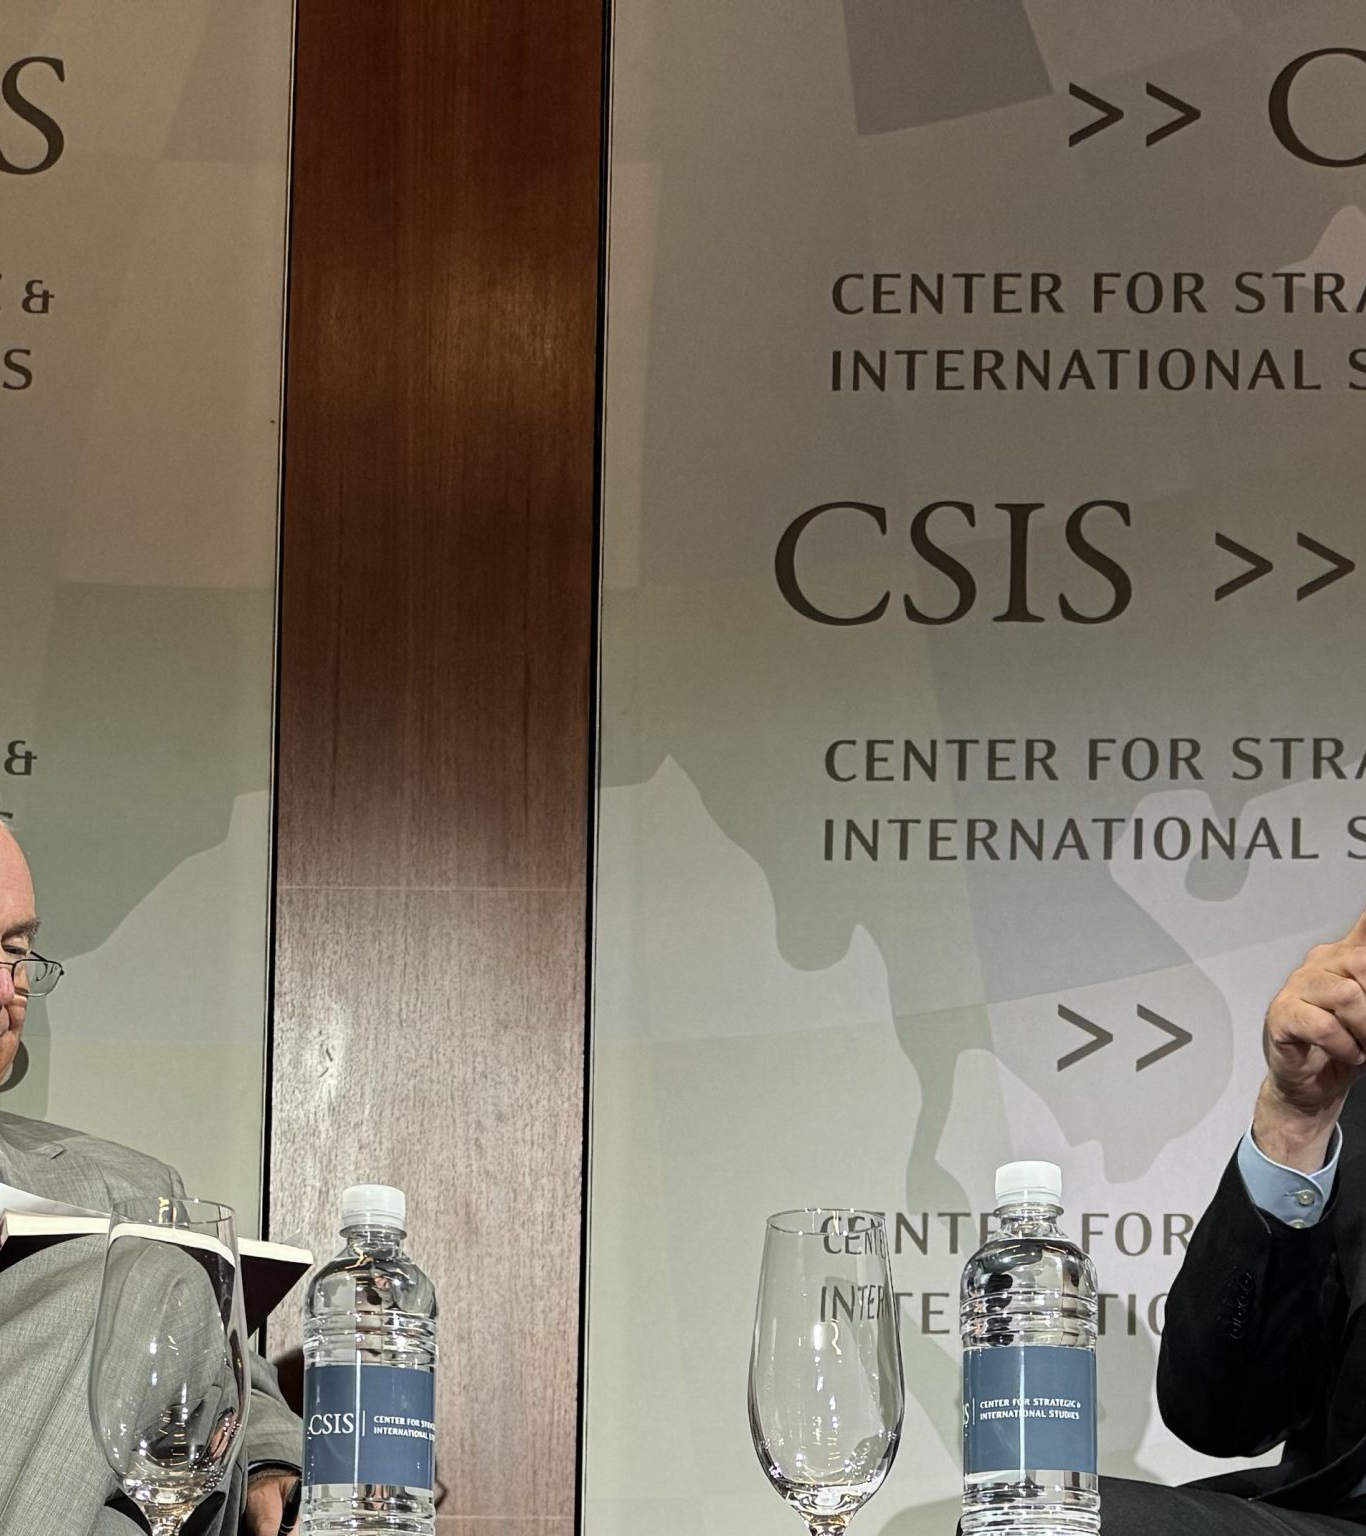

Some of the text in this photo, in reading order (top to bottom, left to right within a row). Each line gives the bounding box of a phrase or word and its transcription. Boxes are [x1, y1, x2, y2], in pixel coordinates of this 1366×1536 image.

[22, 279, 55, 314] &
[832, 272, 1065, 314] CENTER
[1093, 272, 1208, 314] FOR
[832, 348, 1322, 392] INTERNATIONAL
[774, 500, 1133, 626] CSIS
[4, 740, 38, 776] &
[825, 738, 1059, 782] CENTER
[1088, 738, 1204, 781] FOR
[824, 817, 1319, 861] INTERNATIONAL
[1082, 1212, 1194, 1256] FOR
[310, 1413, 354, 1435] CSIS
